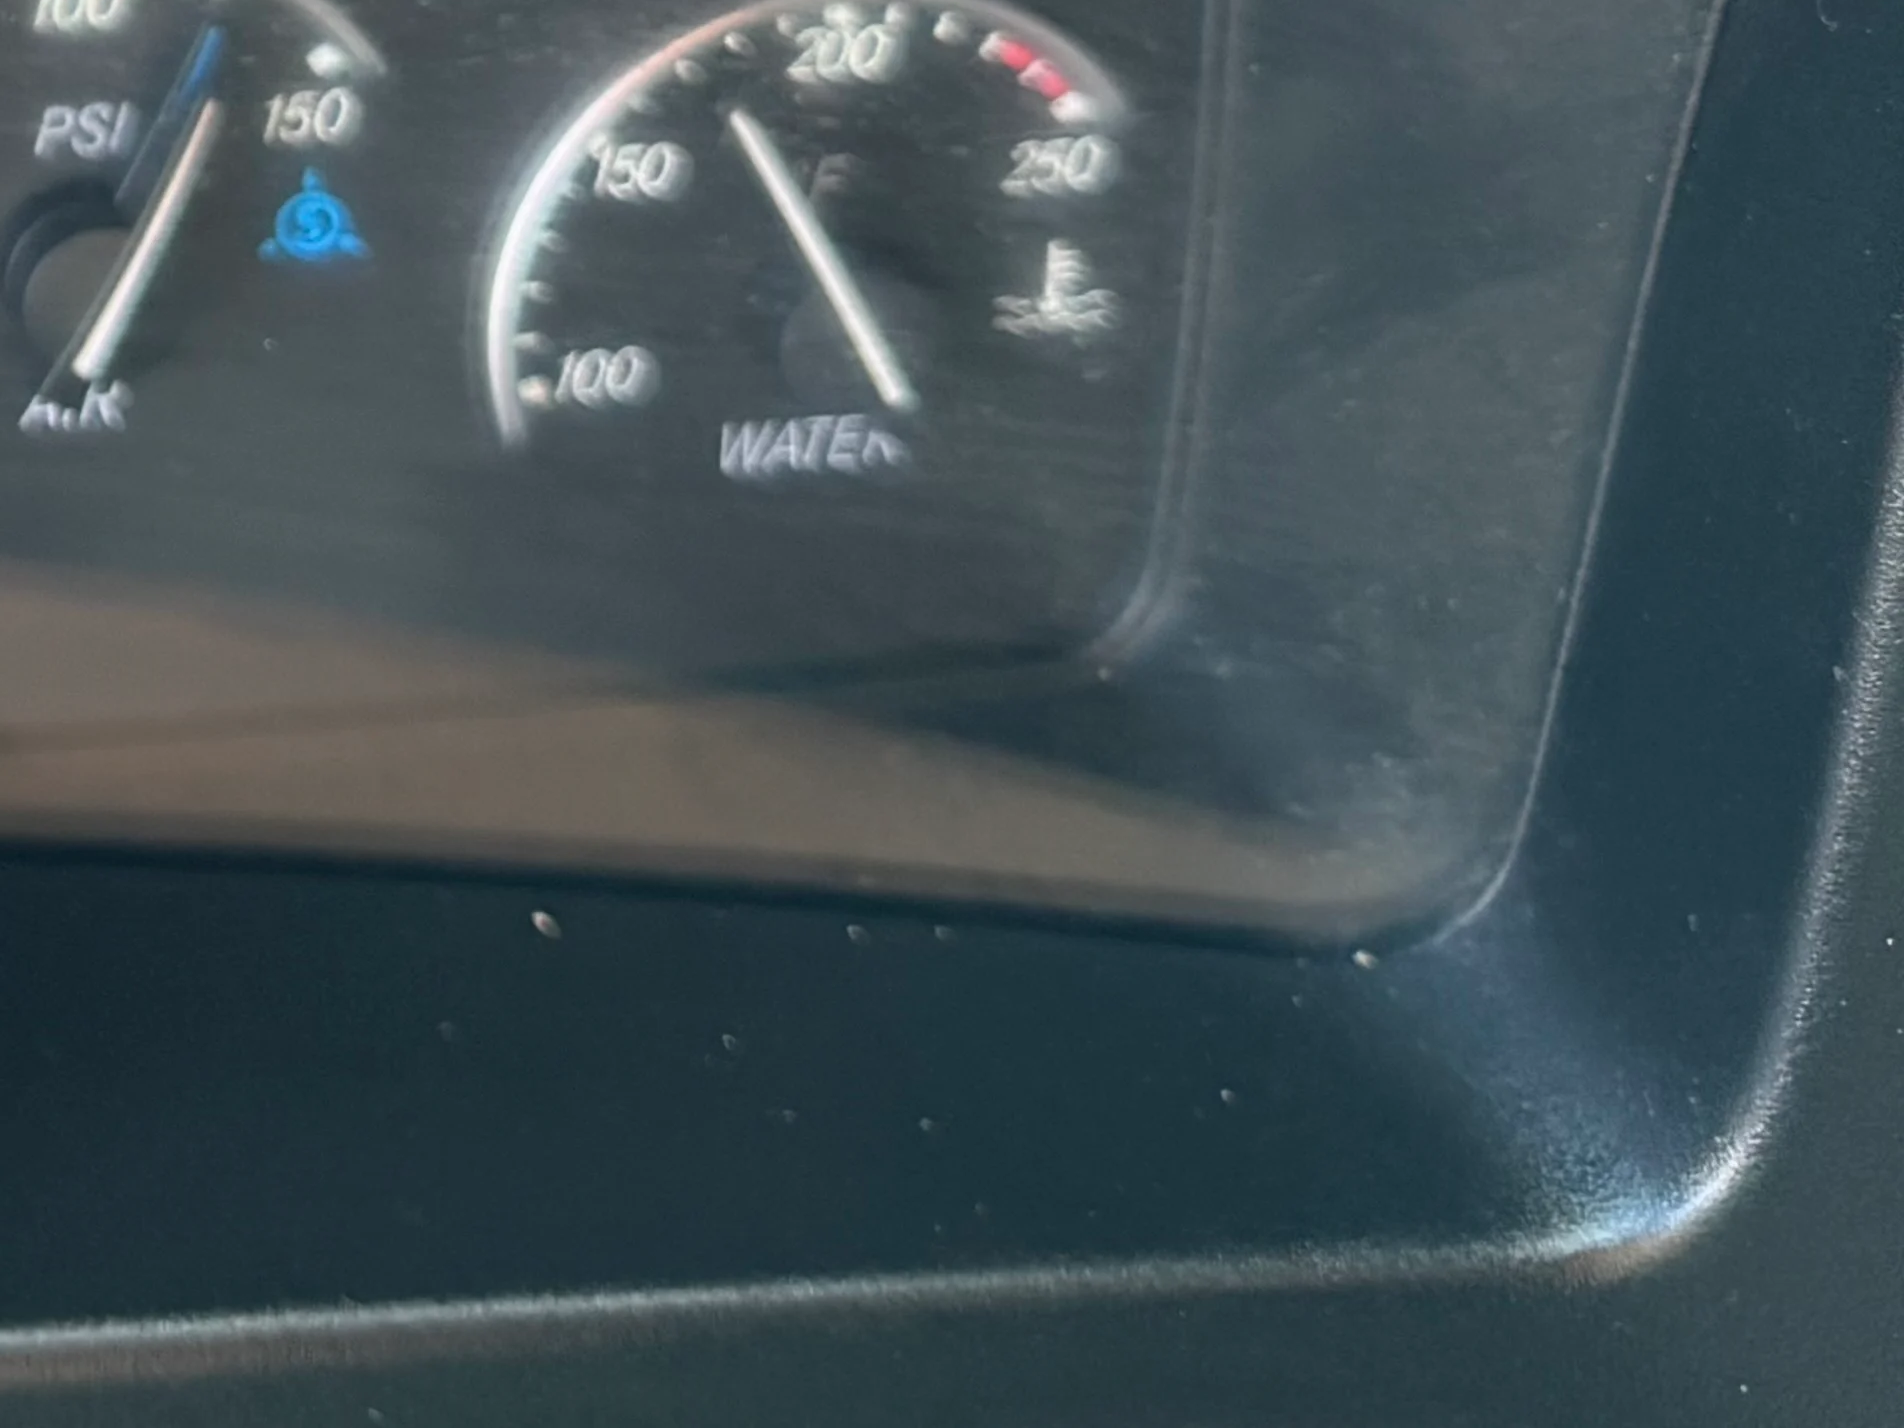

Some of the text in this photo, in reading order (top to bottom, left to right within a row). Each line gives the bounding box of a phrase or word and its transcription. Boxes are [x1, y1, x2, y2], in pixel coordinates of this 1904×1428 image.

[787, 24, 910, 86] 200
[33, 100, 138, 159] PSI
[262, 85, 365, 146] 150
[593, 140, 692, 205] 150
[555, 344, 663, 409] 100
